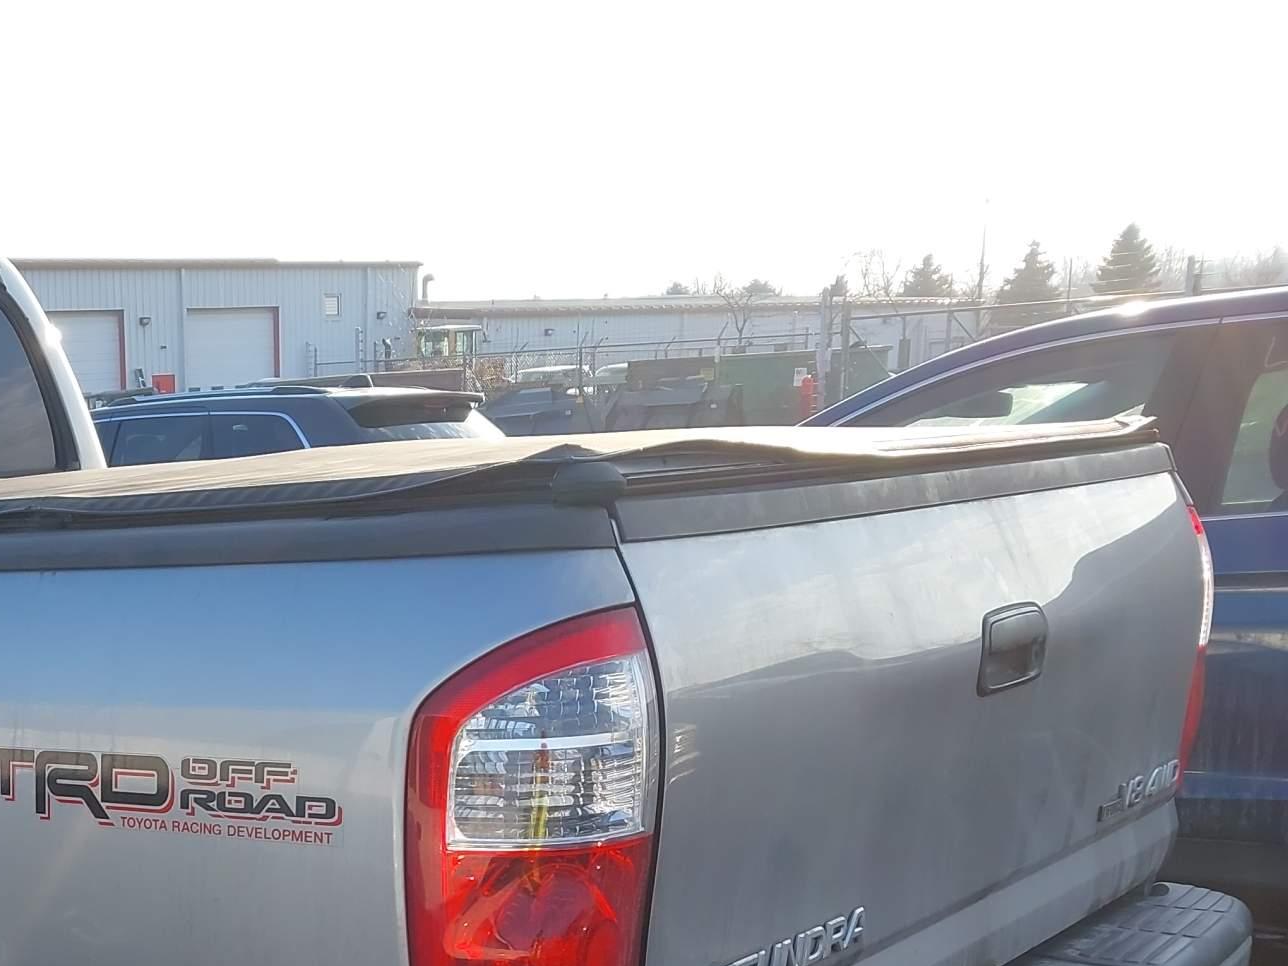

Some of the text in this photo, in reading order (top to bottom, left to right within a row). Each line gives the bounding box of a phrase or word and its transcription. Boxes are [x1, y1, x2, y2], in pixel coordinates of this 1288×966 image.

[181, 756, 298, 789] OFF
[179, 788, 343, 827] ROAD
[120, 815, 333, 845] TOYOTA RACING DEVELOPMENT
